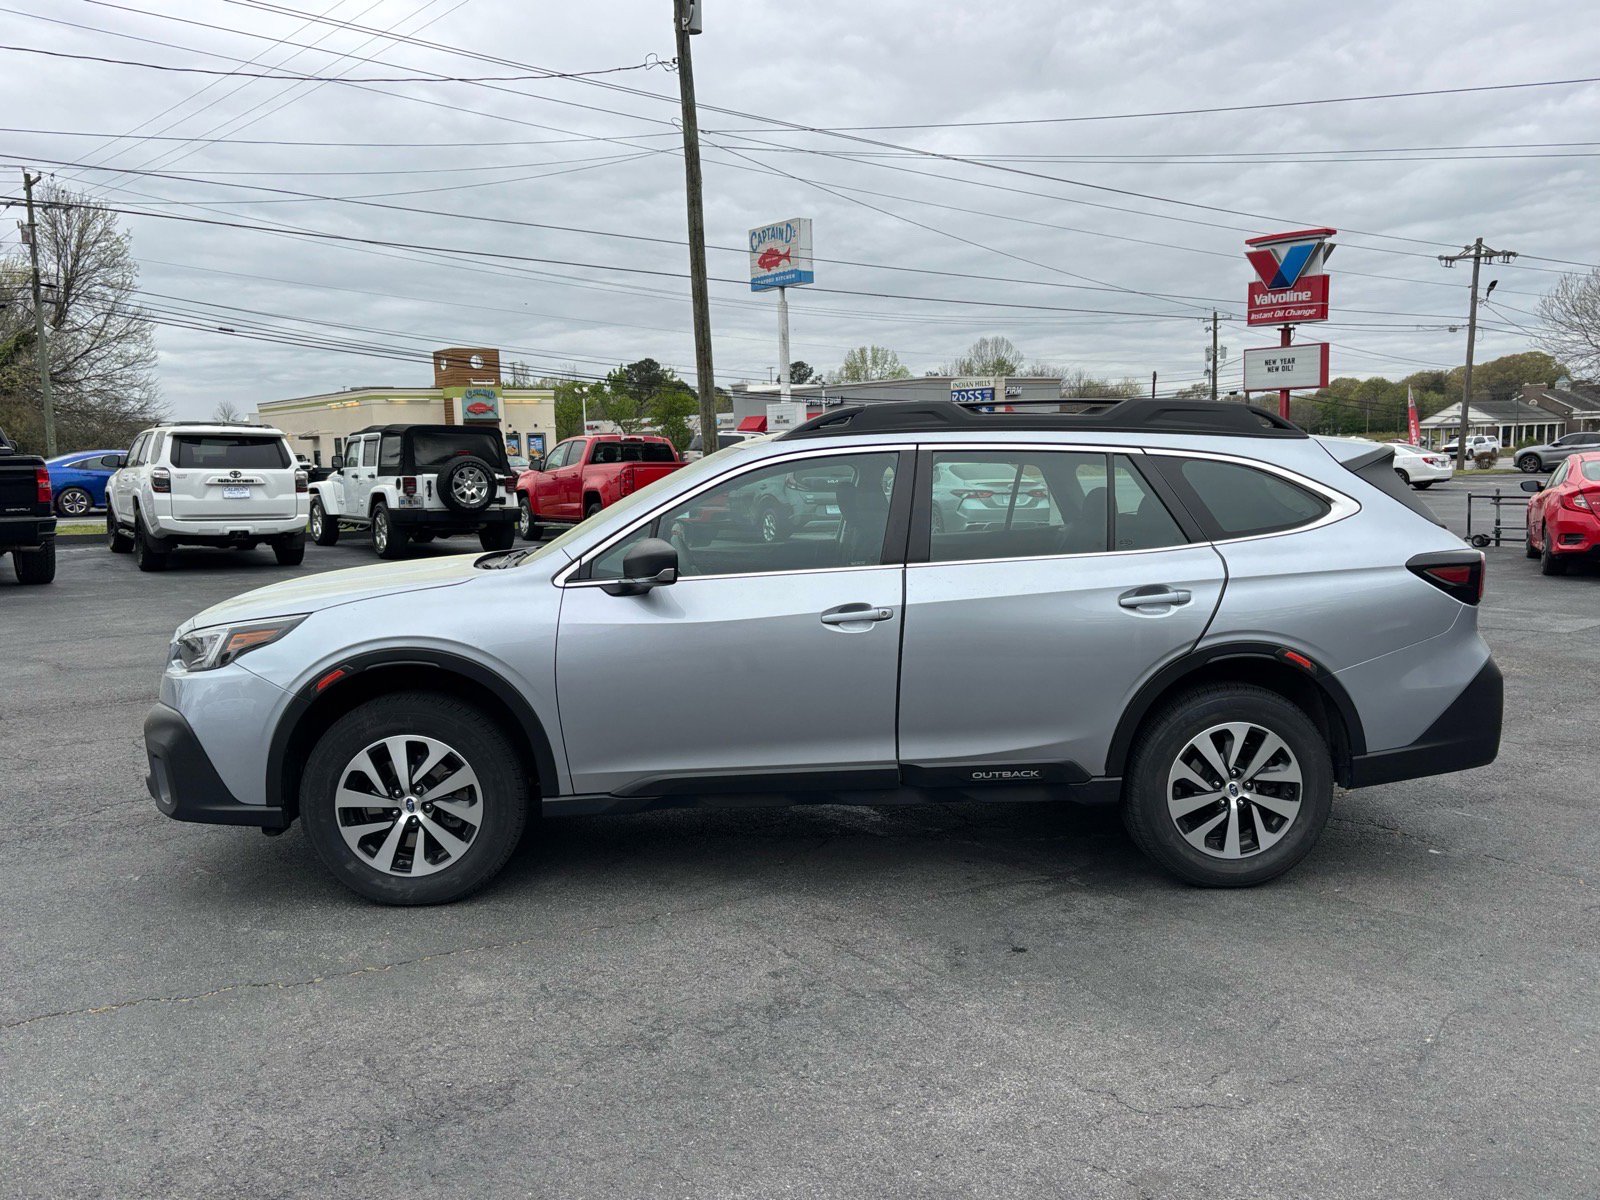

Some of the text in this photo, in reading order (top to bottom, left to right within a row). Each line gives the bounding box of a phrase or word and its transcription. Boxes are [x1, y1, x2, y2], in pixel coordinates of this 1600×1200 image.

[751, 226, 784, 252] CAPTAIN
[1254, 290, 1312, 305] Valvoline
[1250, 308, 1317, 321] Instant Oil Change
[1280, 357, 1295, 365] YEAR
[1268, 364, 1294, 373] NEW OIL!
[975, 380, 991, 388] HILLS
[1005, 386, 1022, 395] FIRM
[952, 390, 982, 402] ROSS
[972, 770, 1040, 779] OUTBACK
